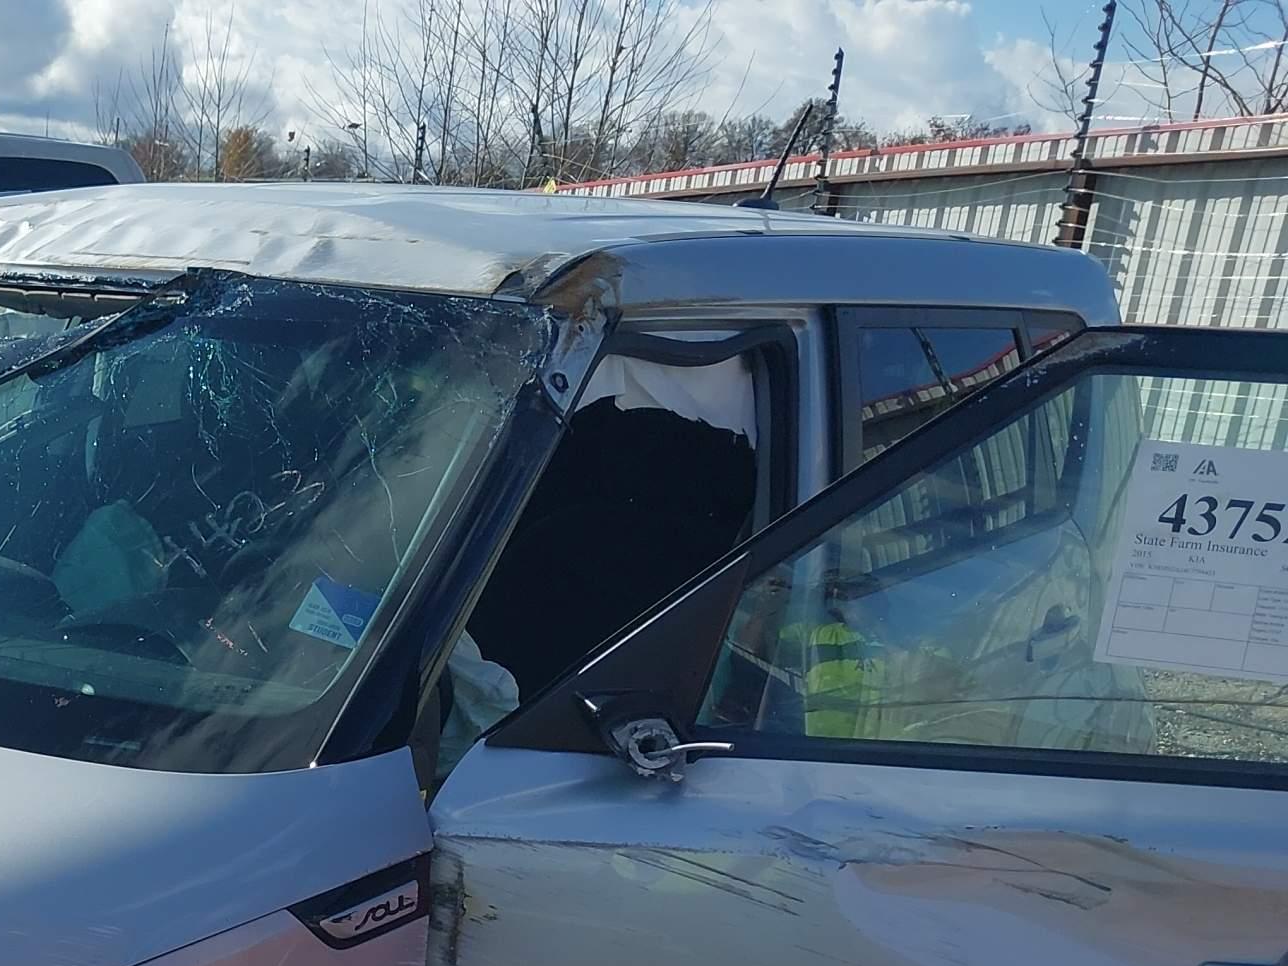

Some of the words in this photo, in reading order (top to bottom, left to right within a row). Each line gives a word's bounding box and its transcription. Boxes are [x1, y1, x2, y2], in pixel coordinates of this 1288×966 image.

[1158, 494, 1288, 544] 4375
[1134, 533, 1166, 547] State
[1170, 536, 1202, 550] Farm
[1207, 541, 1268, 557] Insurance
[1188, 555, 1205, 564] KIA
